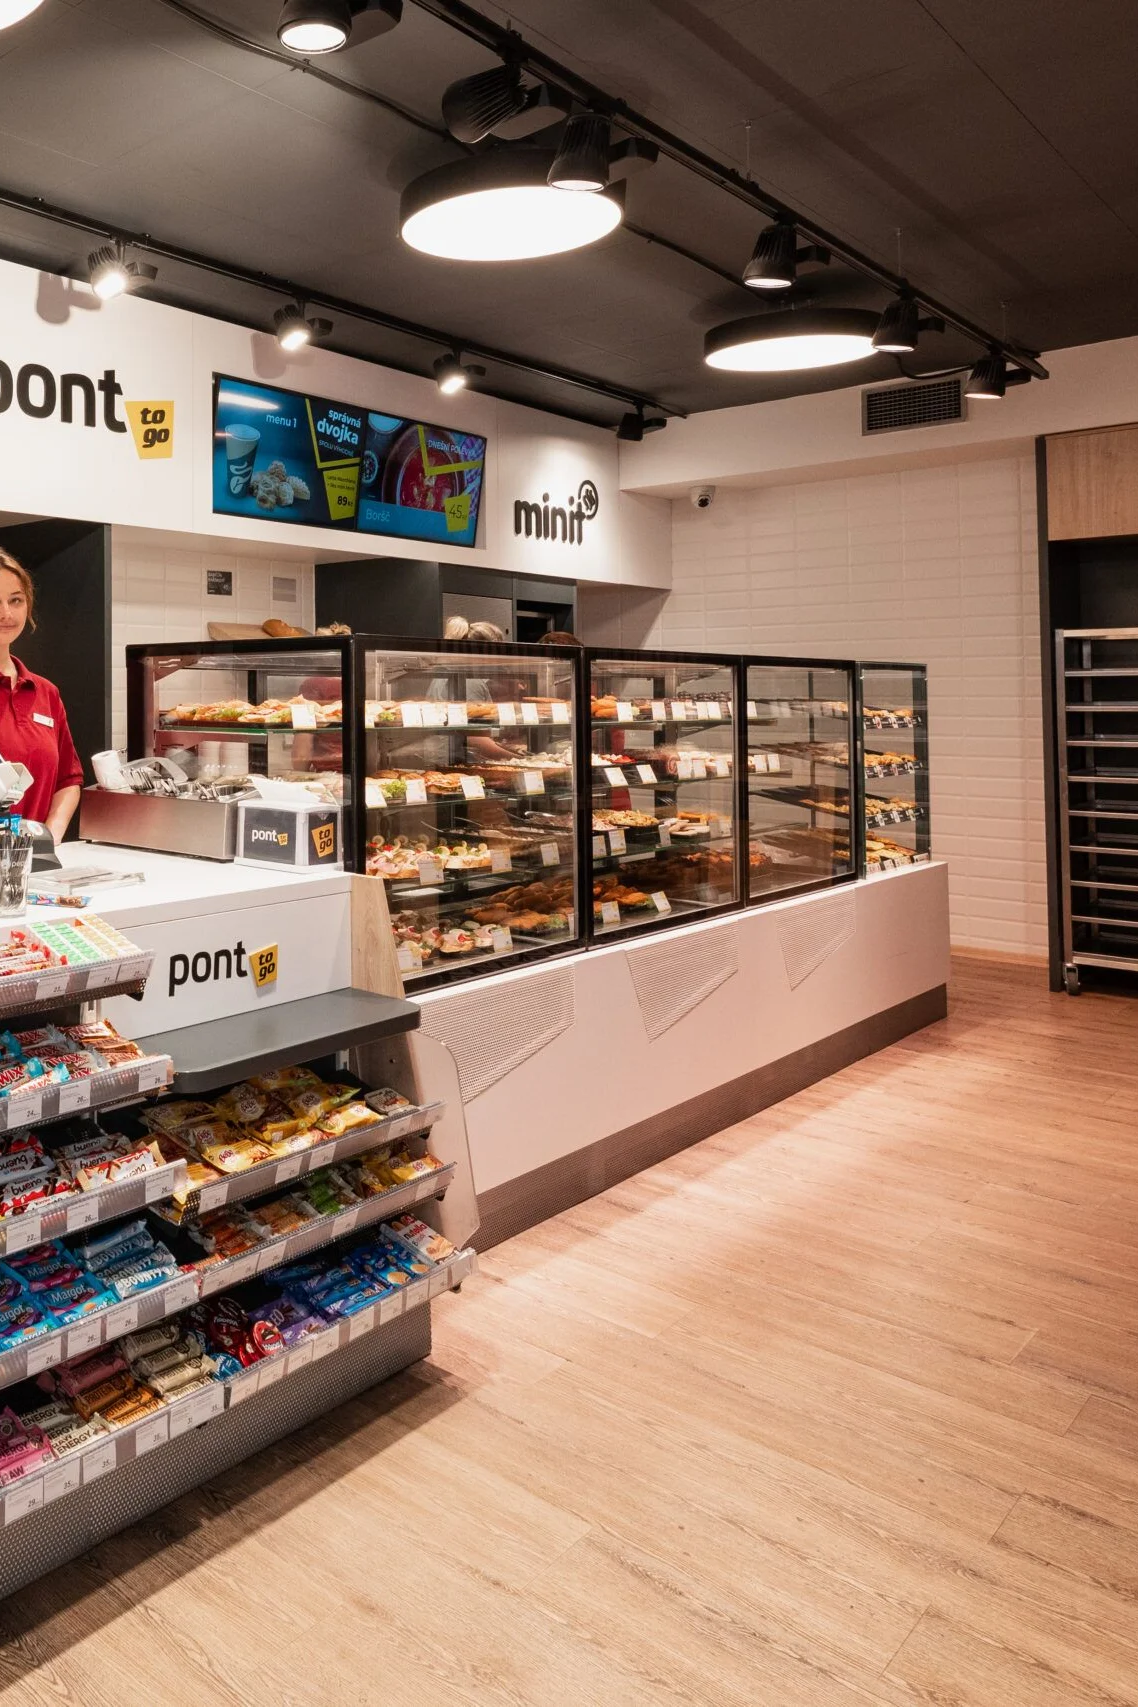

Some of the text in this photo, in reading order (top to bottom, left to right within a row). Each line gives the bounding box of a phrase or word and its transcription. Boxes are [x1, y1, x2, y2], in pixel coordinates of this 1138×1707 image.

[140, 406, 166, 426] to
[265, 413, 290, 426] menu
[328, 408, 361, 428] správná
[142, 426, 170, 449] go
[317, 418, 359, 445] dvojka
[337, 496, 348, 507] 89
[449, 504, 462, 518] 45
[512, 492, 587, 545] minit
[251, 829, 278, 842] pont
[318, 828, 331, 839] to
[319, 838, 332, 853] go
[258, 952, 273, 965] to
[168, 941, 248, 997] pont
[258, 962, 275, 981] go
[74, 1139, 101, 1151] bueno
[57, 1431, 92, 1454] ENERGY
